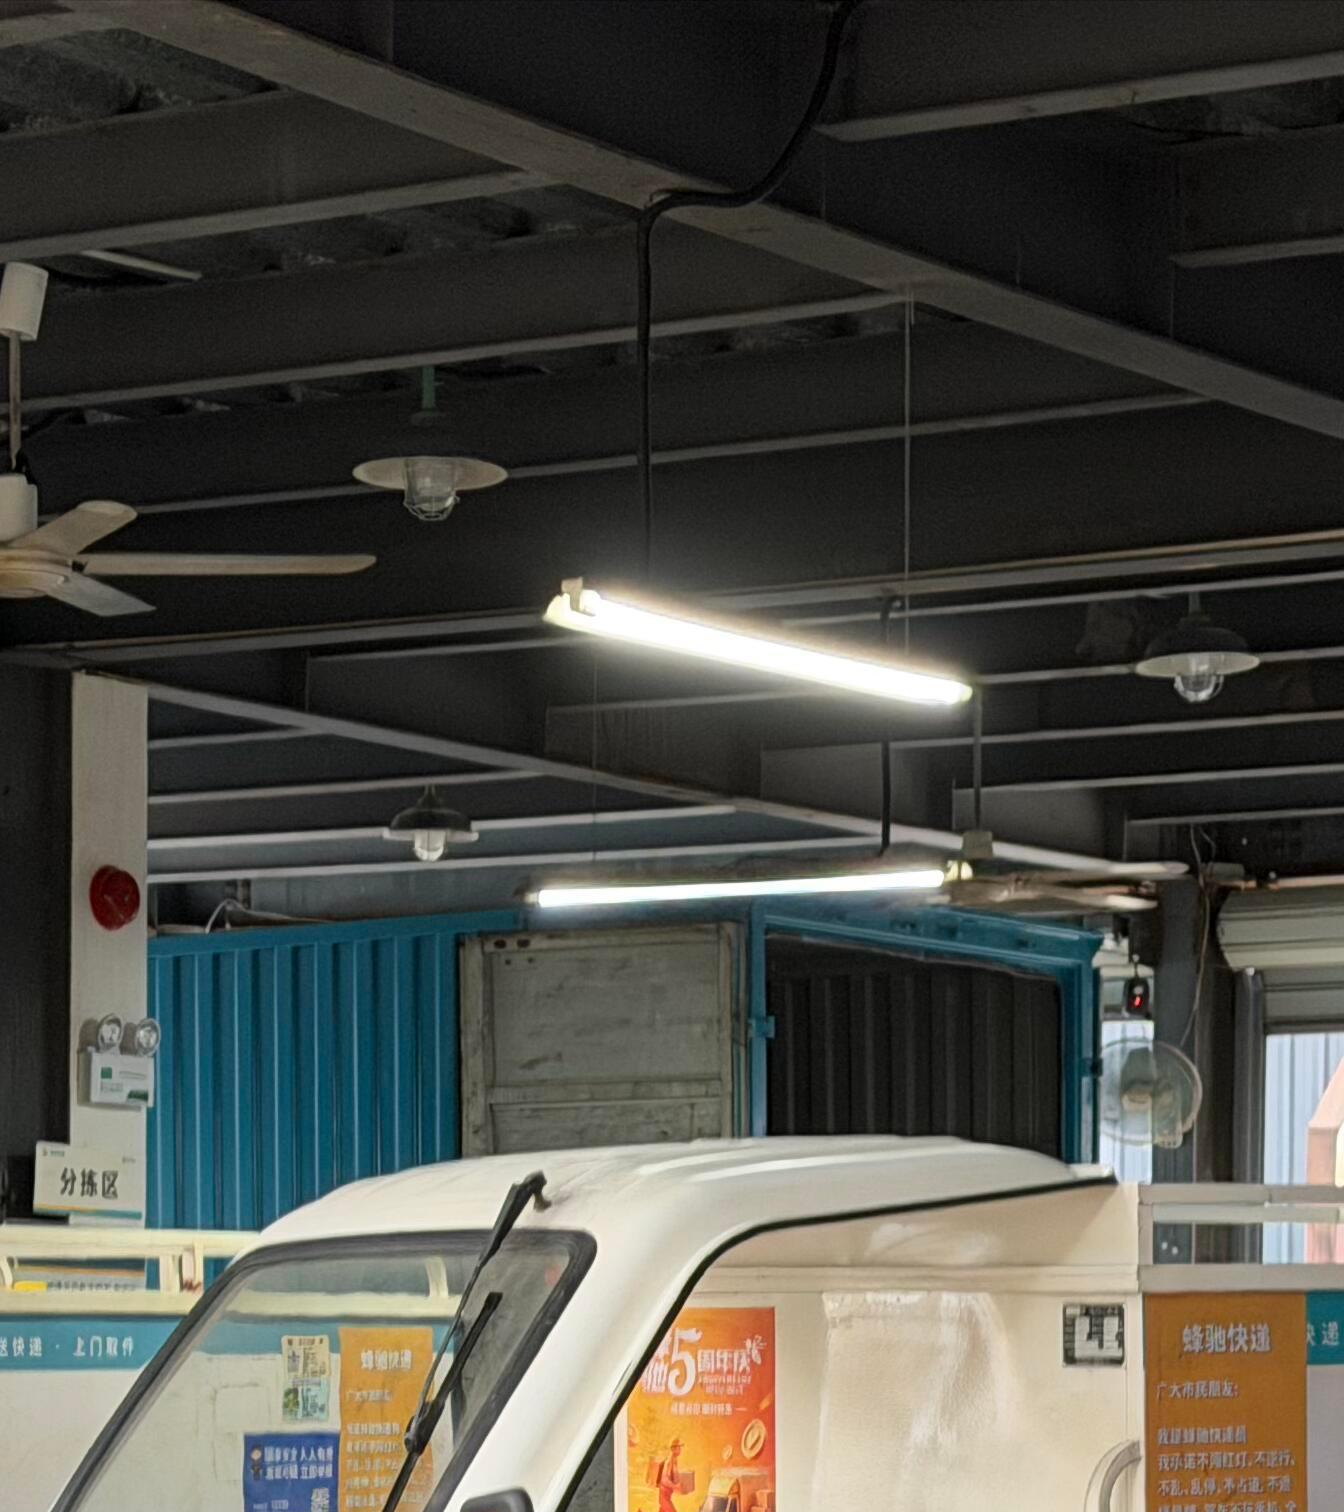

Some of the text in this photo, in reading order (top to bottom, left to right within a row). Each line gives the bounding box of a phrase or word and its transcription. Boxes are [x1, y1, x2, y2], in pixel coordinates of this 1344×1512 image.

[60, 1167, 118, 1199] 分拣区
[72, 1336, 135, 1357] 上门取件
[1182, 1322, 1271, 1353] 蜂驰快递
